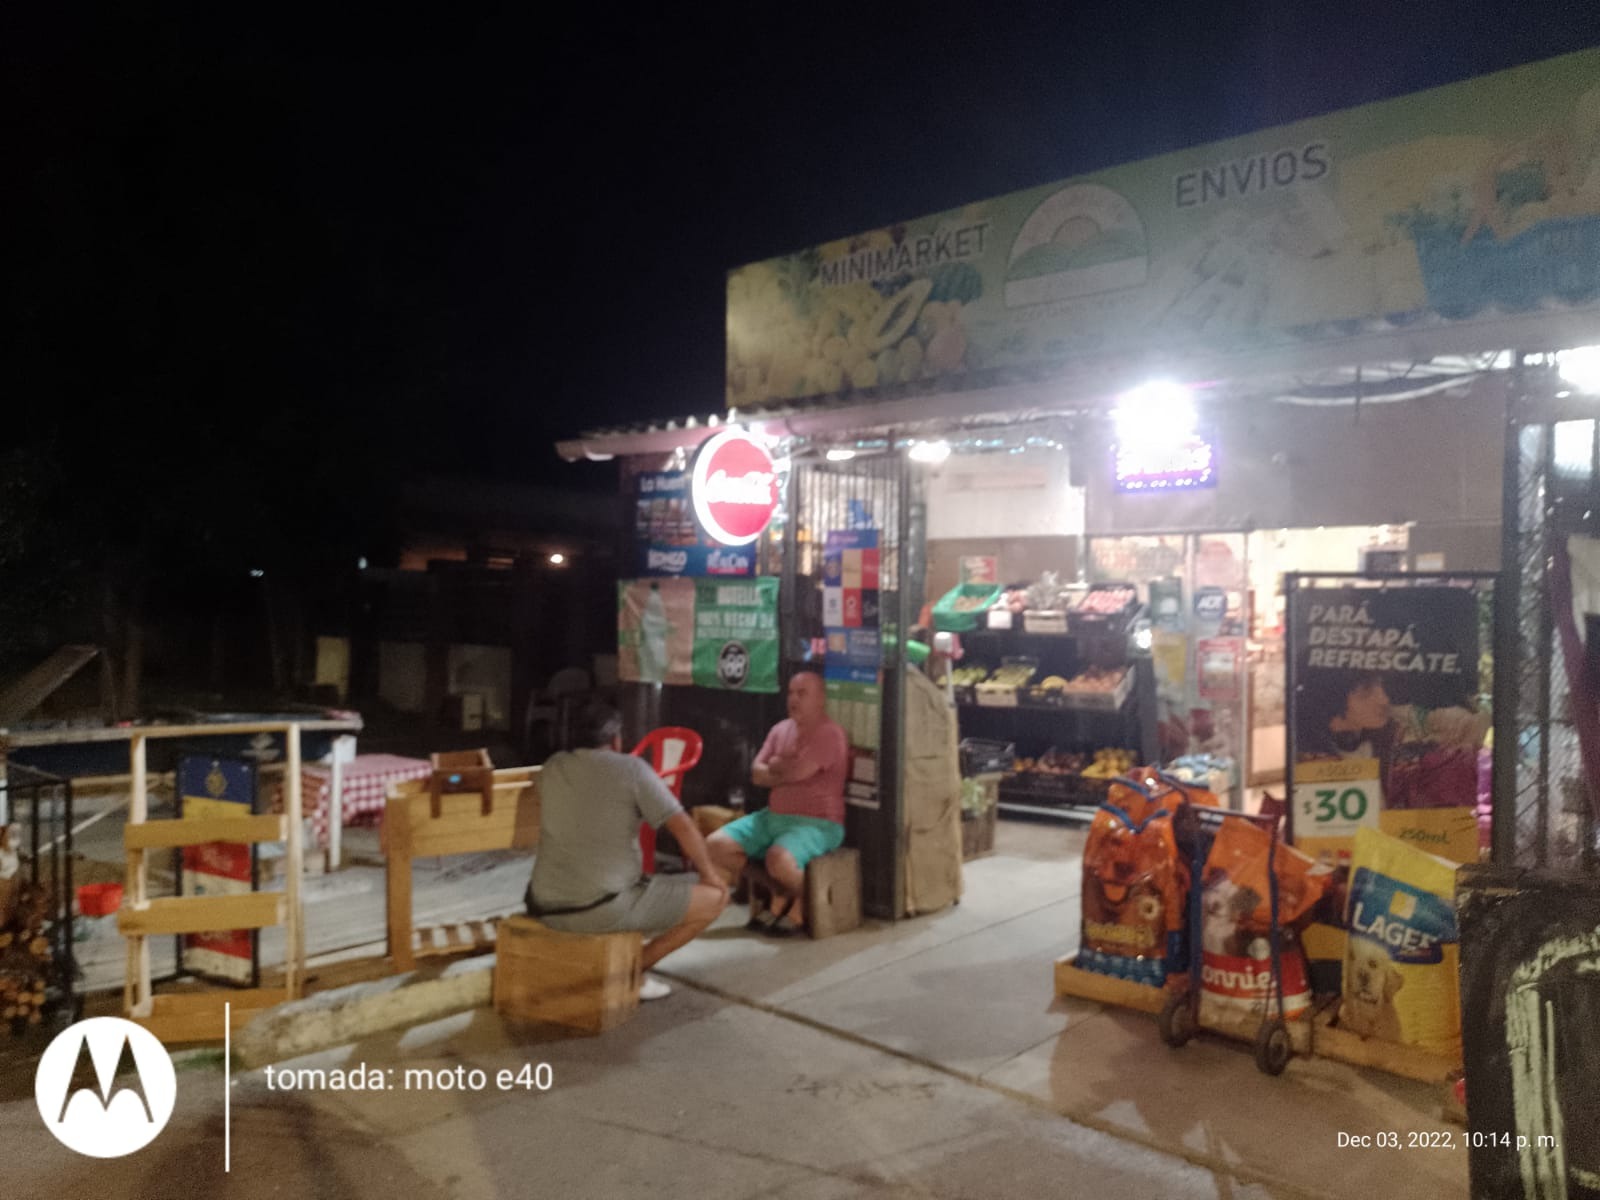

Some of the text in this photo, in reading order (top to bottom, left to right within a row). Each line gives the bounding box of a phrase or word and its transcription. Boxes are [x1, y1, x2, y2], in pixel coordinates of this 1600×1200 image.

[1175, 143, 1327, 208] ENVIOS
[820, 222, 989, 288] MINIMARKET
[1308, 624, 1421, 649] DESTAPÁ.
[1307, 648, 1463, 675] REFRESCATE.
